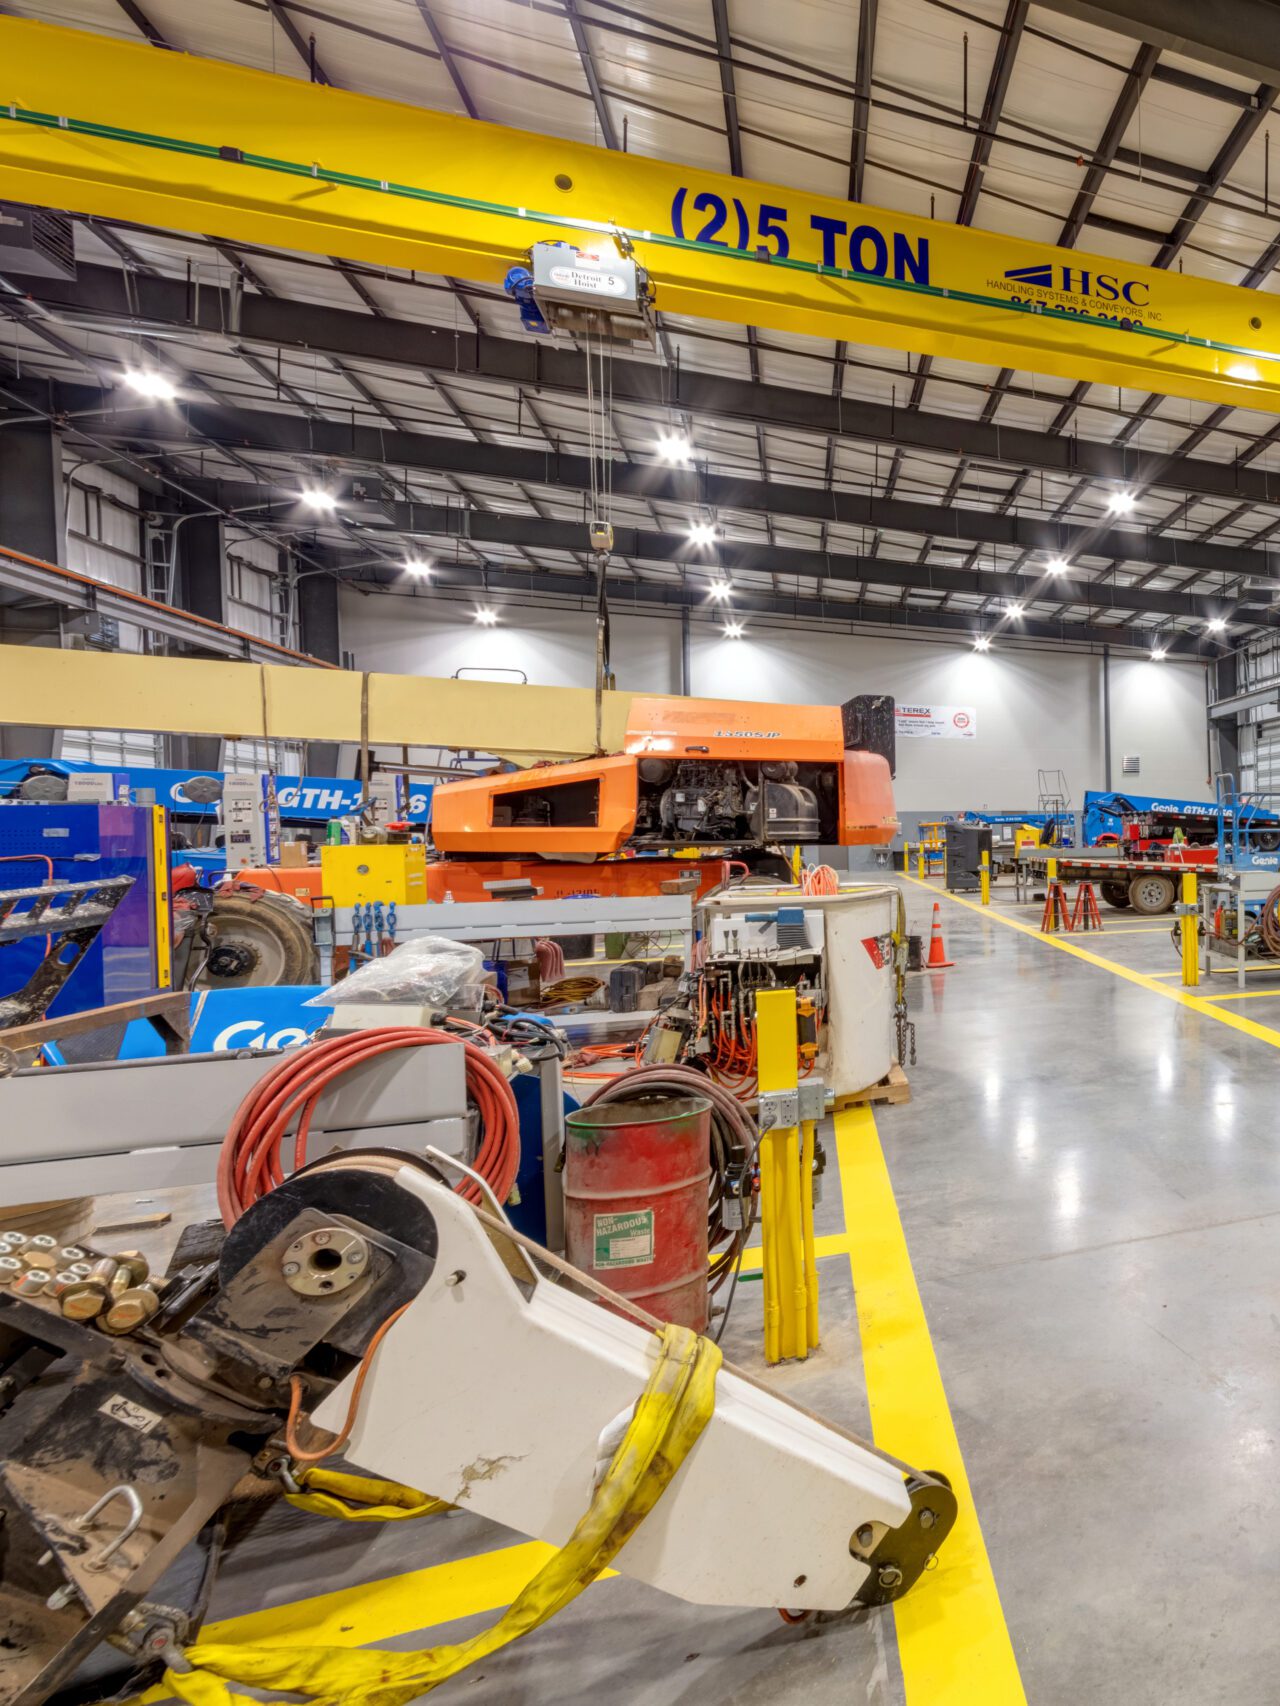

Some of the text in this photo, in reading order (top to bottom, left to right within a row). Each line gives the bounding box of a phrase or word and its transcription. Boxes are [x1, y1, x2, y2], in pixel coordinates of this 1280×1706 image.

[671, 187, 929, 286] (2)5 TON
[571, 271, 602, 283] Detroit
[607, 276, 615, 286] 5
[574, 278, 597, 289] Hoist
[1057, 266, 1150, 307] HSC
[986, 279, 1034, 297] HANDLING
[1036, 288, 1080, 306] SYSTEMS
[1081, 299, 1088, 307] &
[1089, 299, 1146, 320] CONVEYORS,
[902, 707, 931, 715] TEREX
[277, 787, 428, 815] GTH-16
[1151, 802, 1179, 813] Genie
[1252, 855, 1278, 865] Genie
[597, 1216, 618, 1227] NON-
[597, 1215, 649, 1237] HAZARDOUS
